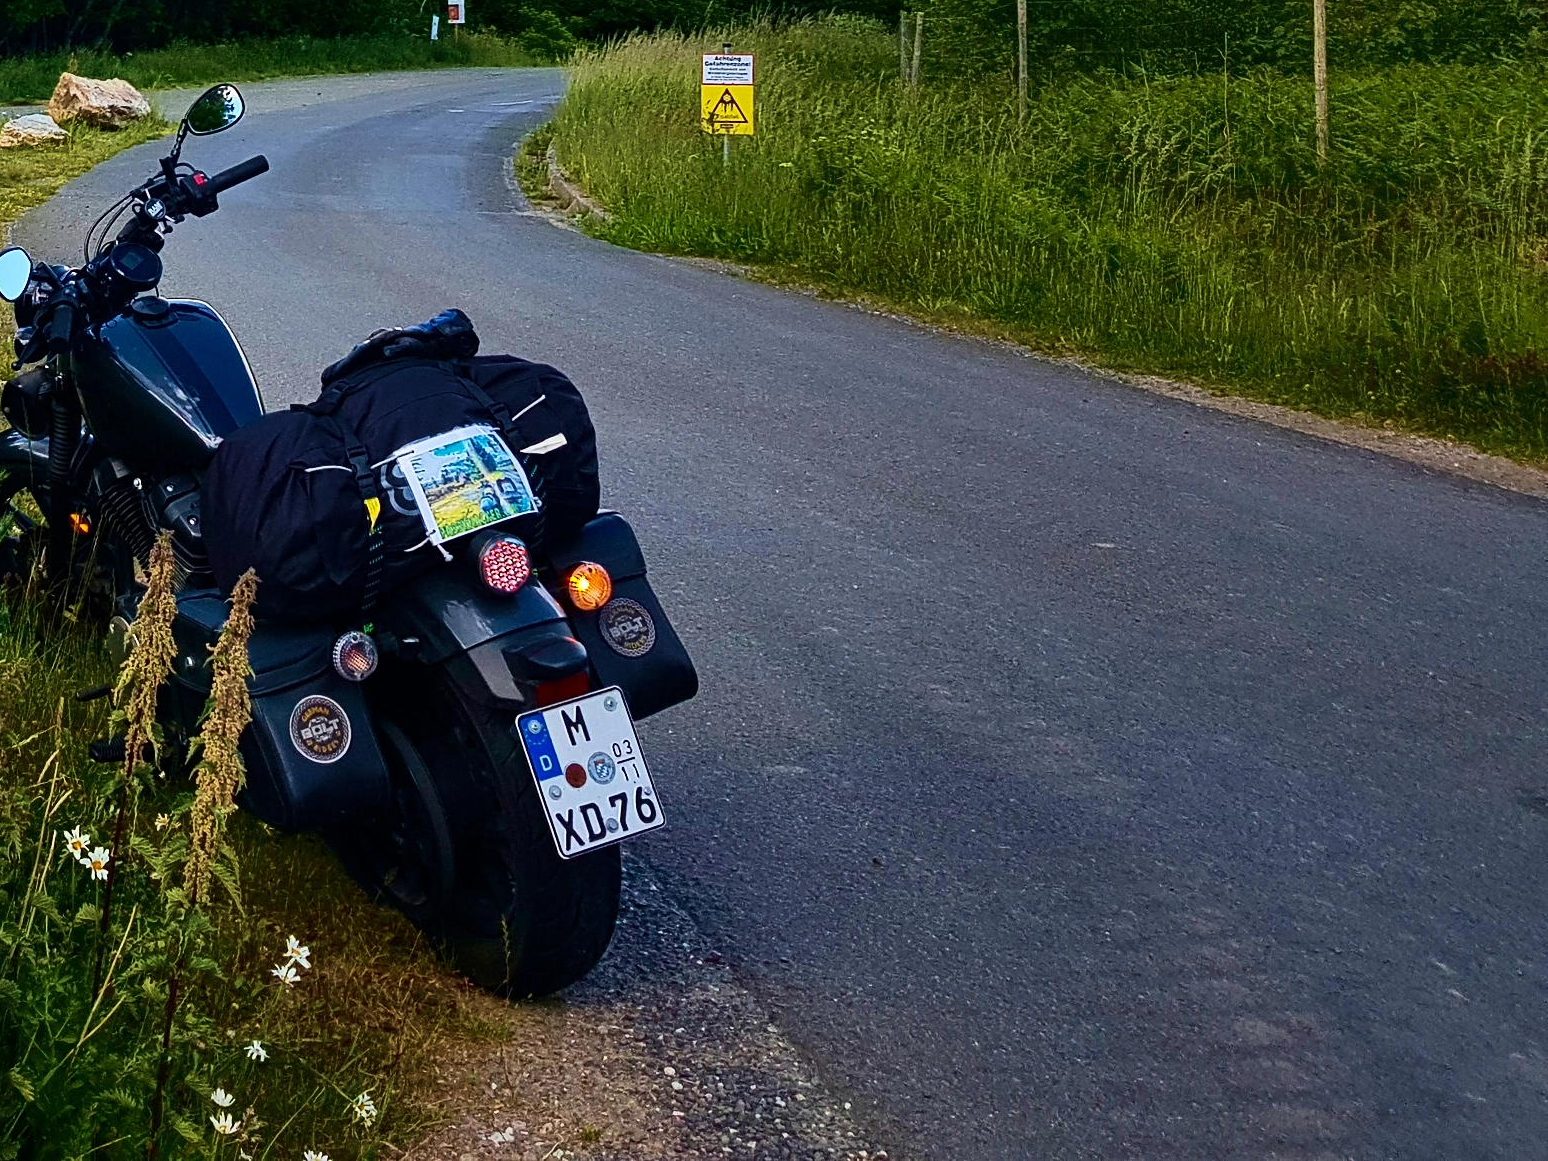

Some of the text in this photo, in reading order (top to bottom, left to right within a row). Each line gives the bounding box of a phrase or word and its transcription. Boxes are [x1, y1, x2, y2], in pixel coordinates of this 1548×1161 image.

[609, 617, 642, 637] BOLT
[301, 719, 339, 739] BOLT
[561, 706, 591, 746] M
[612, 739, 633, 758] 03
[540, 754, 553, 772] D
[621, 763, 640, 782] 11
